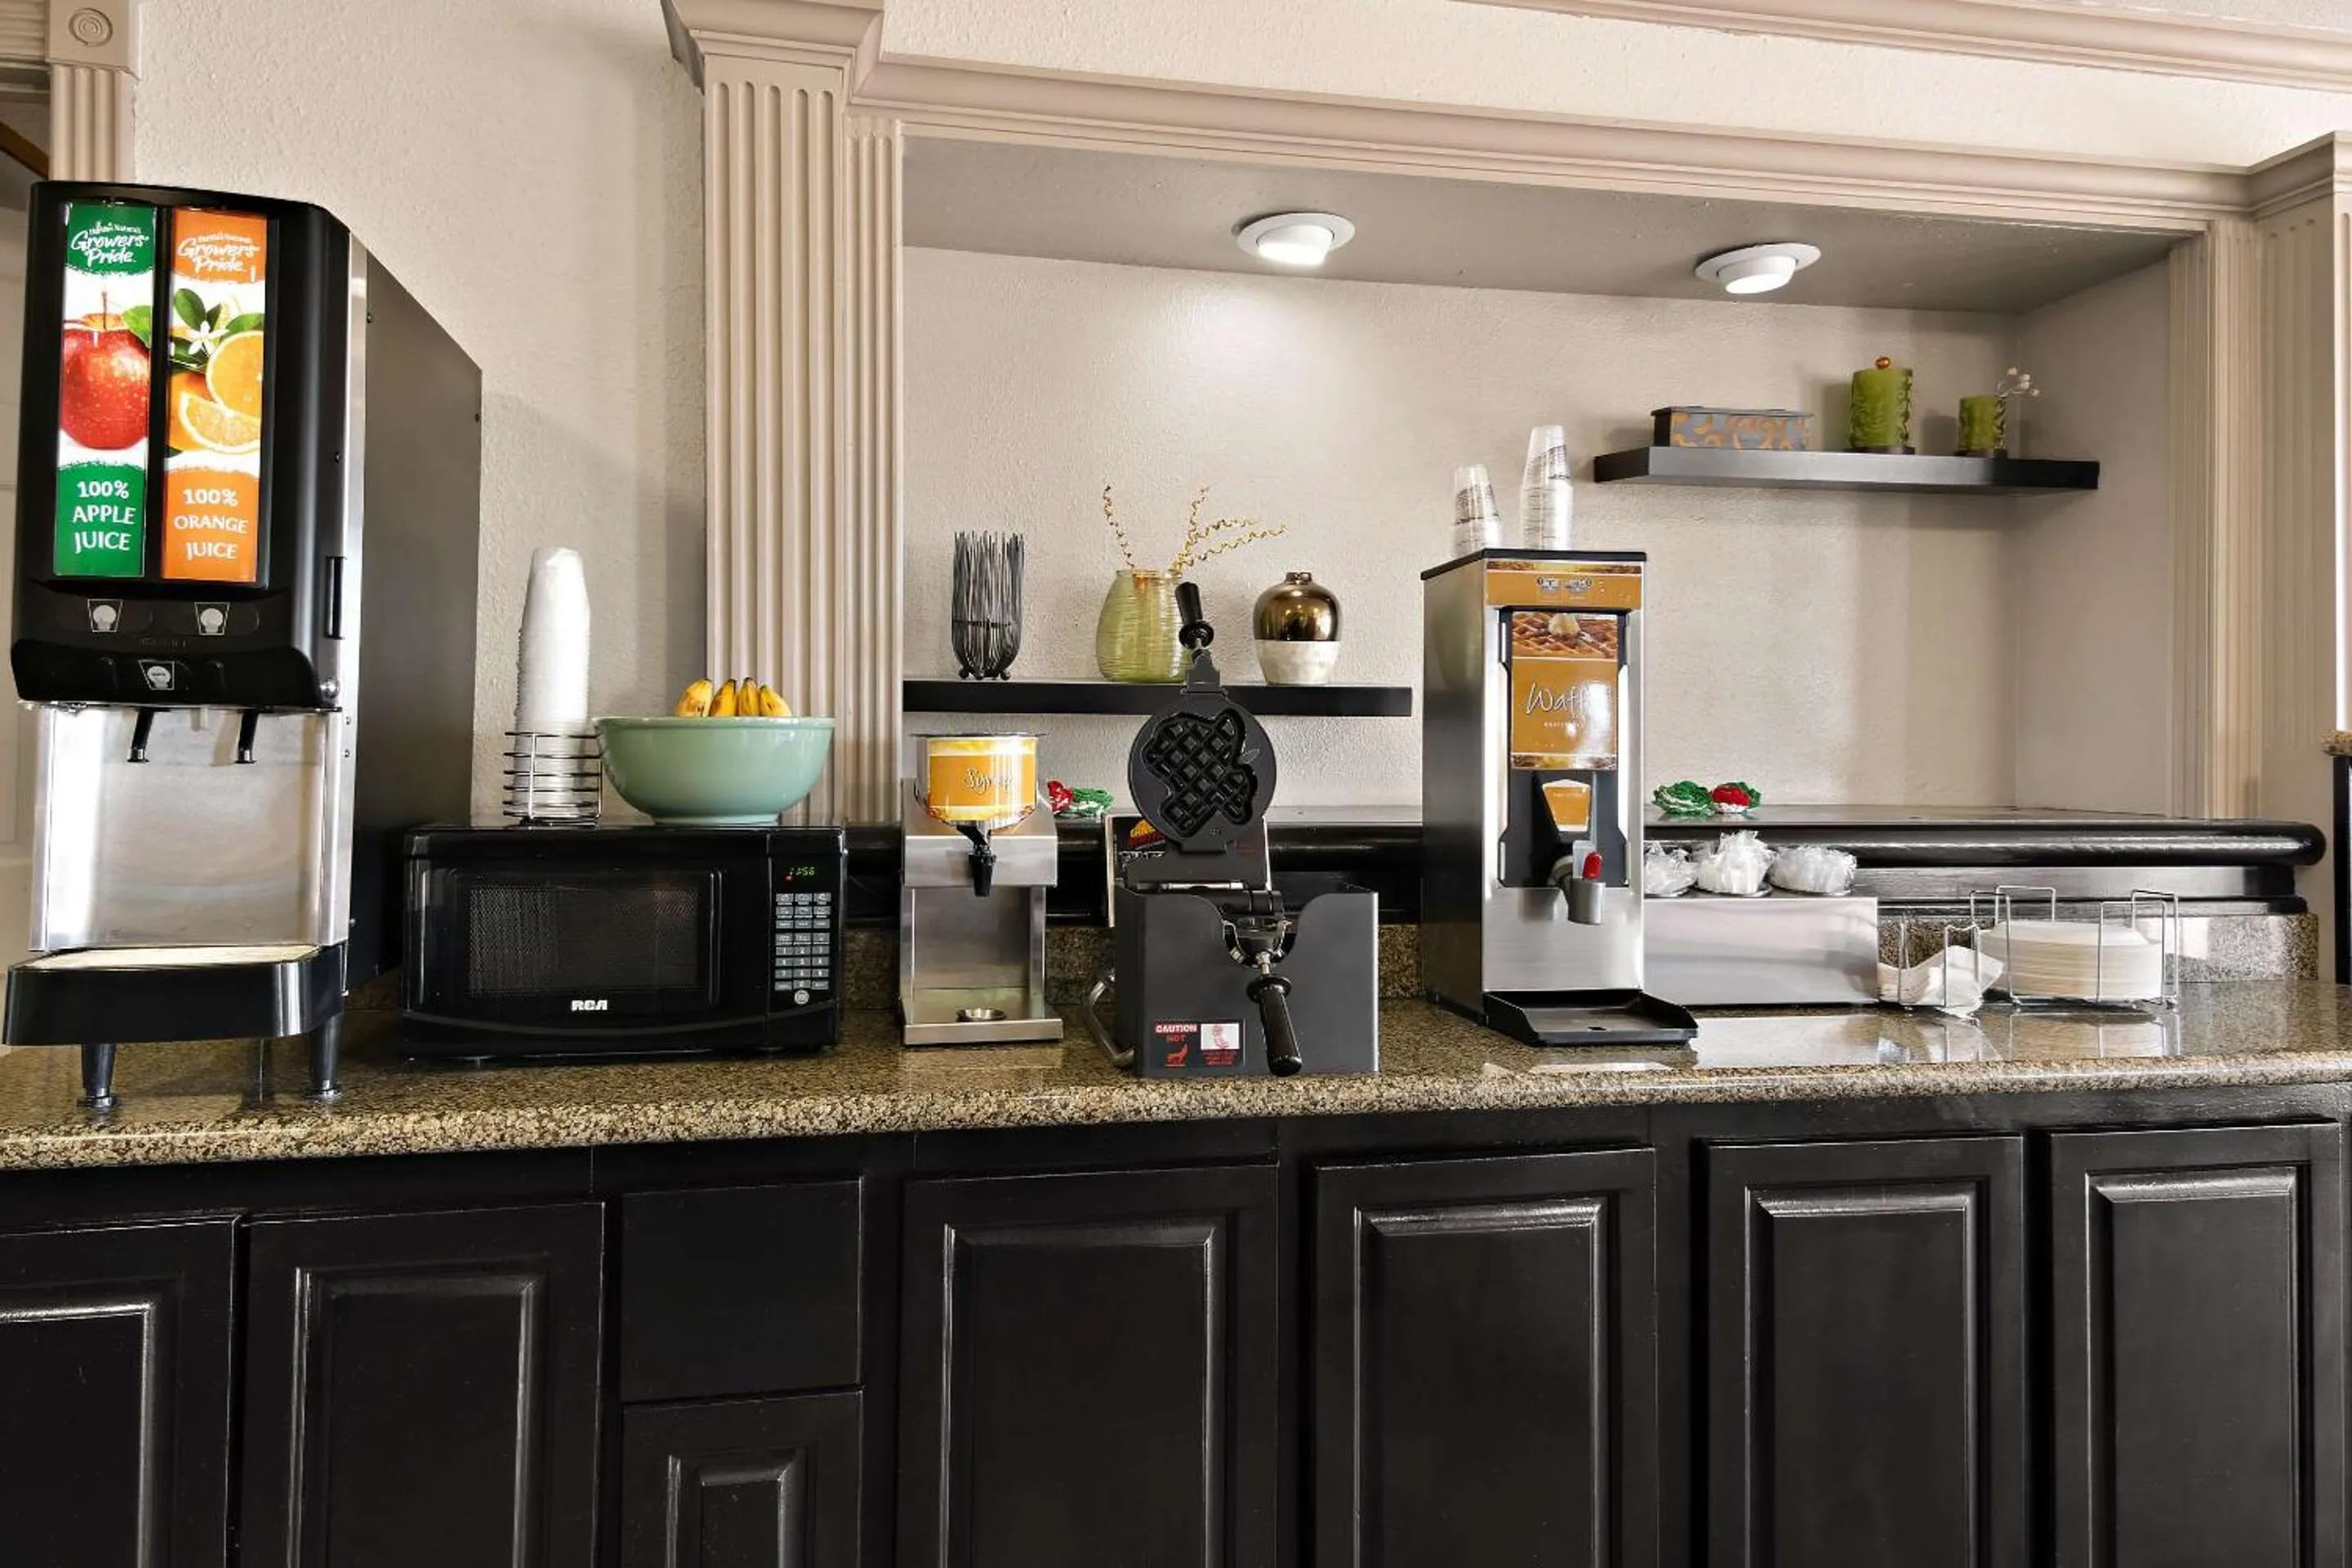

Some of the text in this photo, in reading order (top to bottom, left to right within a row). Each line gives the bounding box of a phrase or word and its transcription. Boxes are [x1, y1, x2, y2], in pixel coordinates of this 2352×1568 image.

[71, 229, 149, 252] Growers
[77, 480, 130, 499] 100%
[183, 488, 238, 507] 100%
[73, 505, 136, 524] APPLE
[174, 514, 248, 533] ORANGE
[74, 531, 131, 554] JUICE
[185, 542, 238, 560] JUICE
[572, 1000, 608, 1011] RCA
[1155, 1024, 1197, 1033] CAUTION
